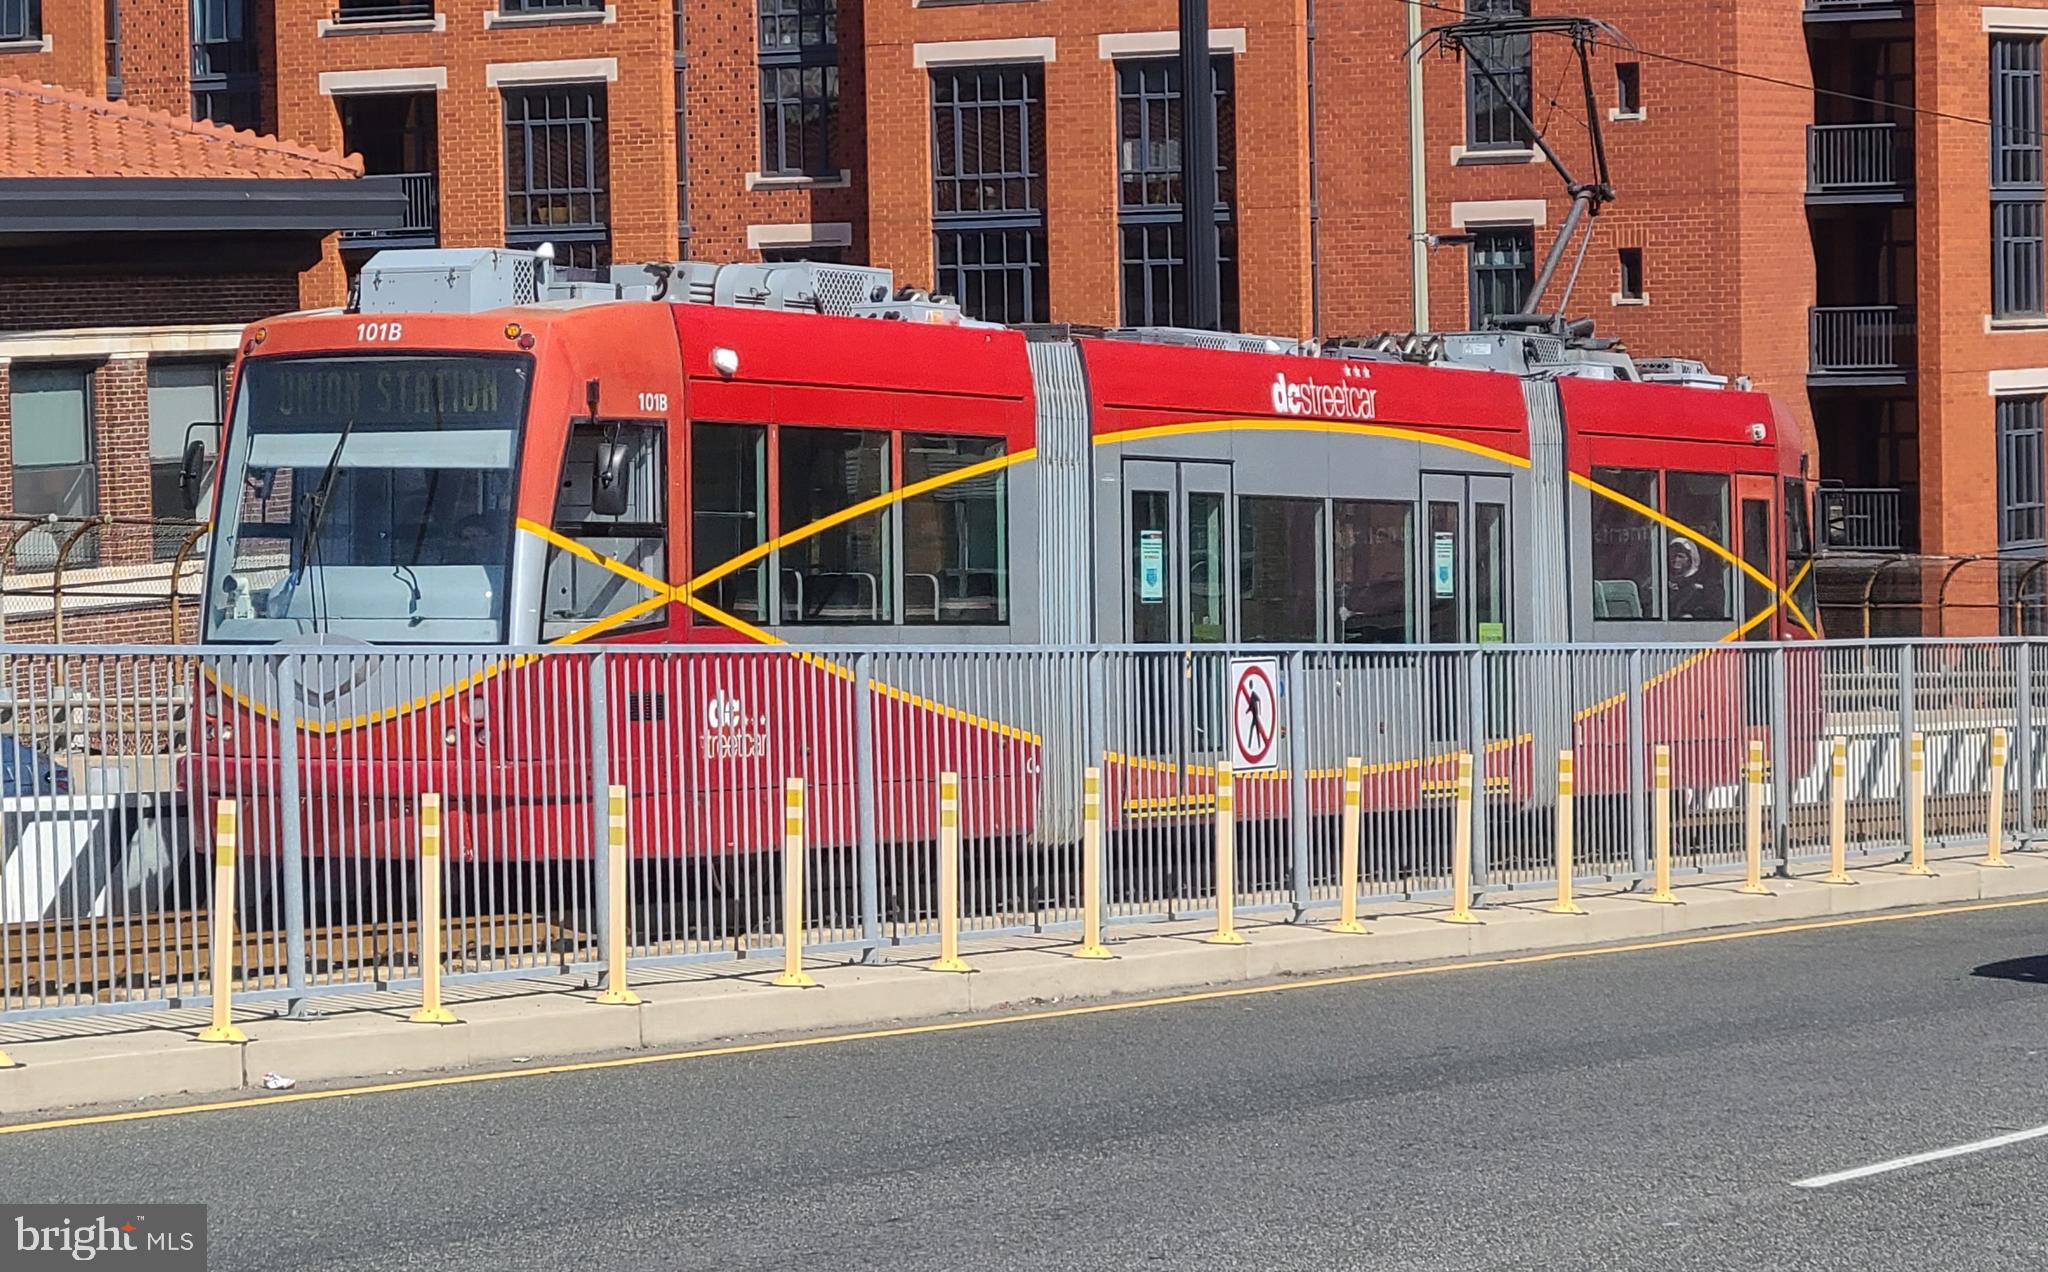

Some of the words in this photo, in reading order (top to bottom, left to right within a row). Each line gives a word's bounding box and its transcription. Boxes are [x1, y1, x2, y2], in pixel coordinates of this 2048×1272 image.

[357, 322, 402, 341] 101B
[280, 368, 361, 415] UNION
[376, 367, 498, 413] STATION
[638, 392, 668, 411] 101B
